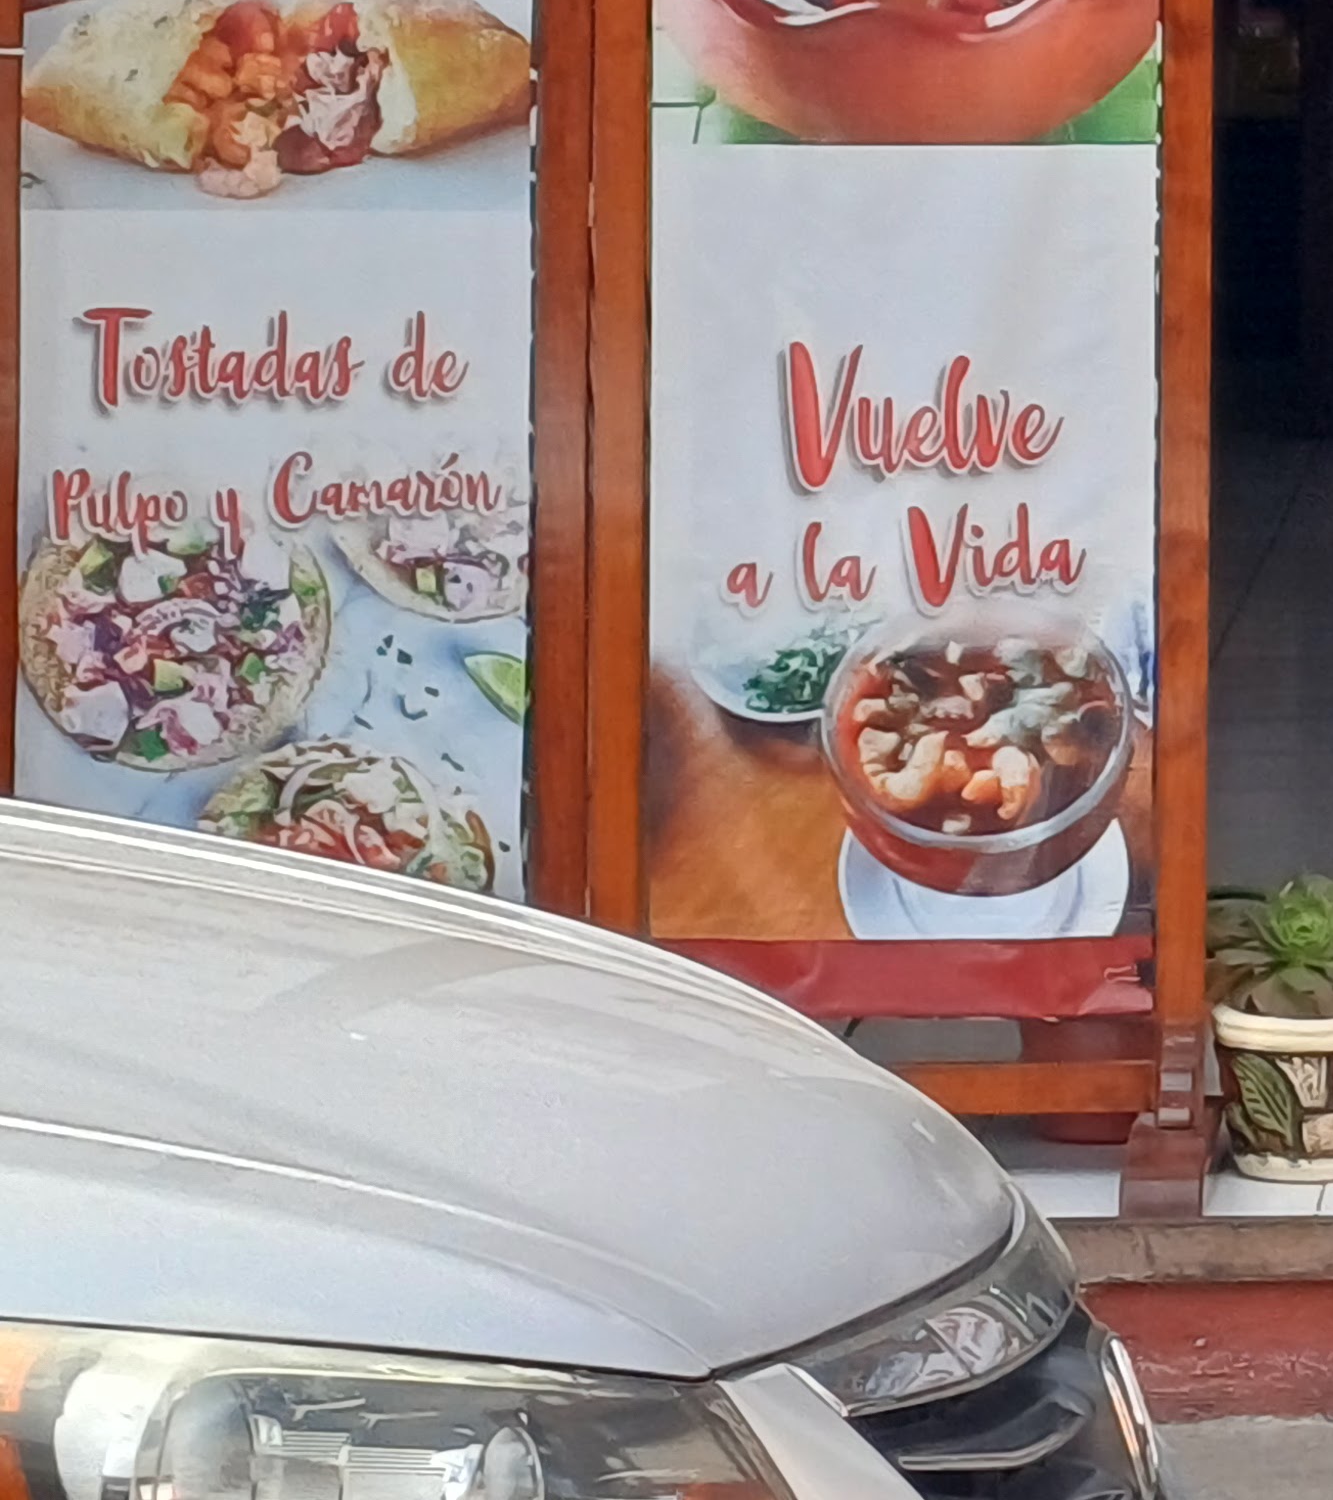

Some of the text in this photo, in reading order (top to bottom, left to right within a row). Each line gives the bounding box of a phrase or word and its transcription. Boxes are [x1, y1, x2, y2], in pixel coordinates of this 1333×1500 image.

[80, 306, 470, 408] Tostadas de
[786, 340, 1066, 490] Vuelve
[51, 450, 505, 557] Pulpo y Camarón
[724, 501, 1086, 610] a la Vida
